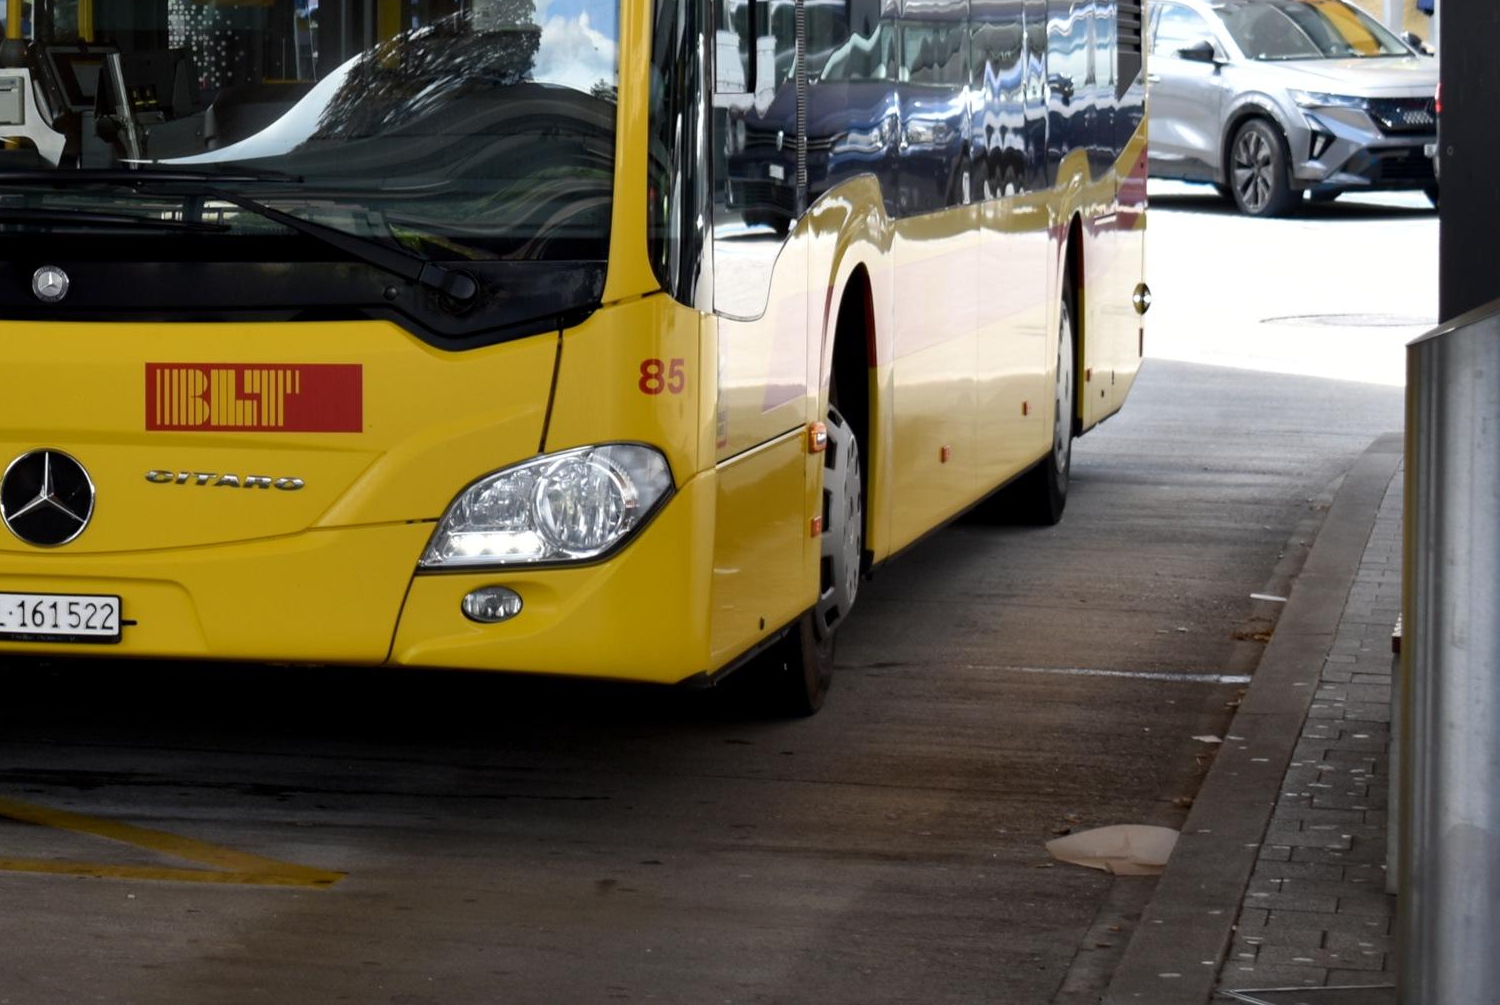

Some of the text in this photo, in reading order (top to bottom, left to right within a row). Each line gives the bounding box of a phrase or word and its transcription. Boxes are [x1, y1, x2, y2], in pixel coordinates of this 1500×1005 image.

[154, 367, 301, 427] BLT
[637, 358, 686, 397] 85
[144, 469, 306, 493] CITARO
